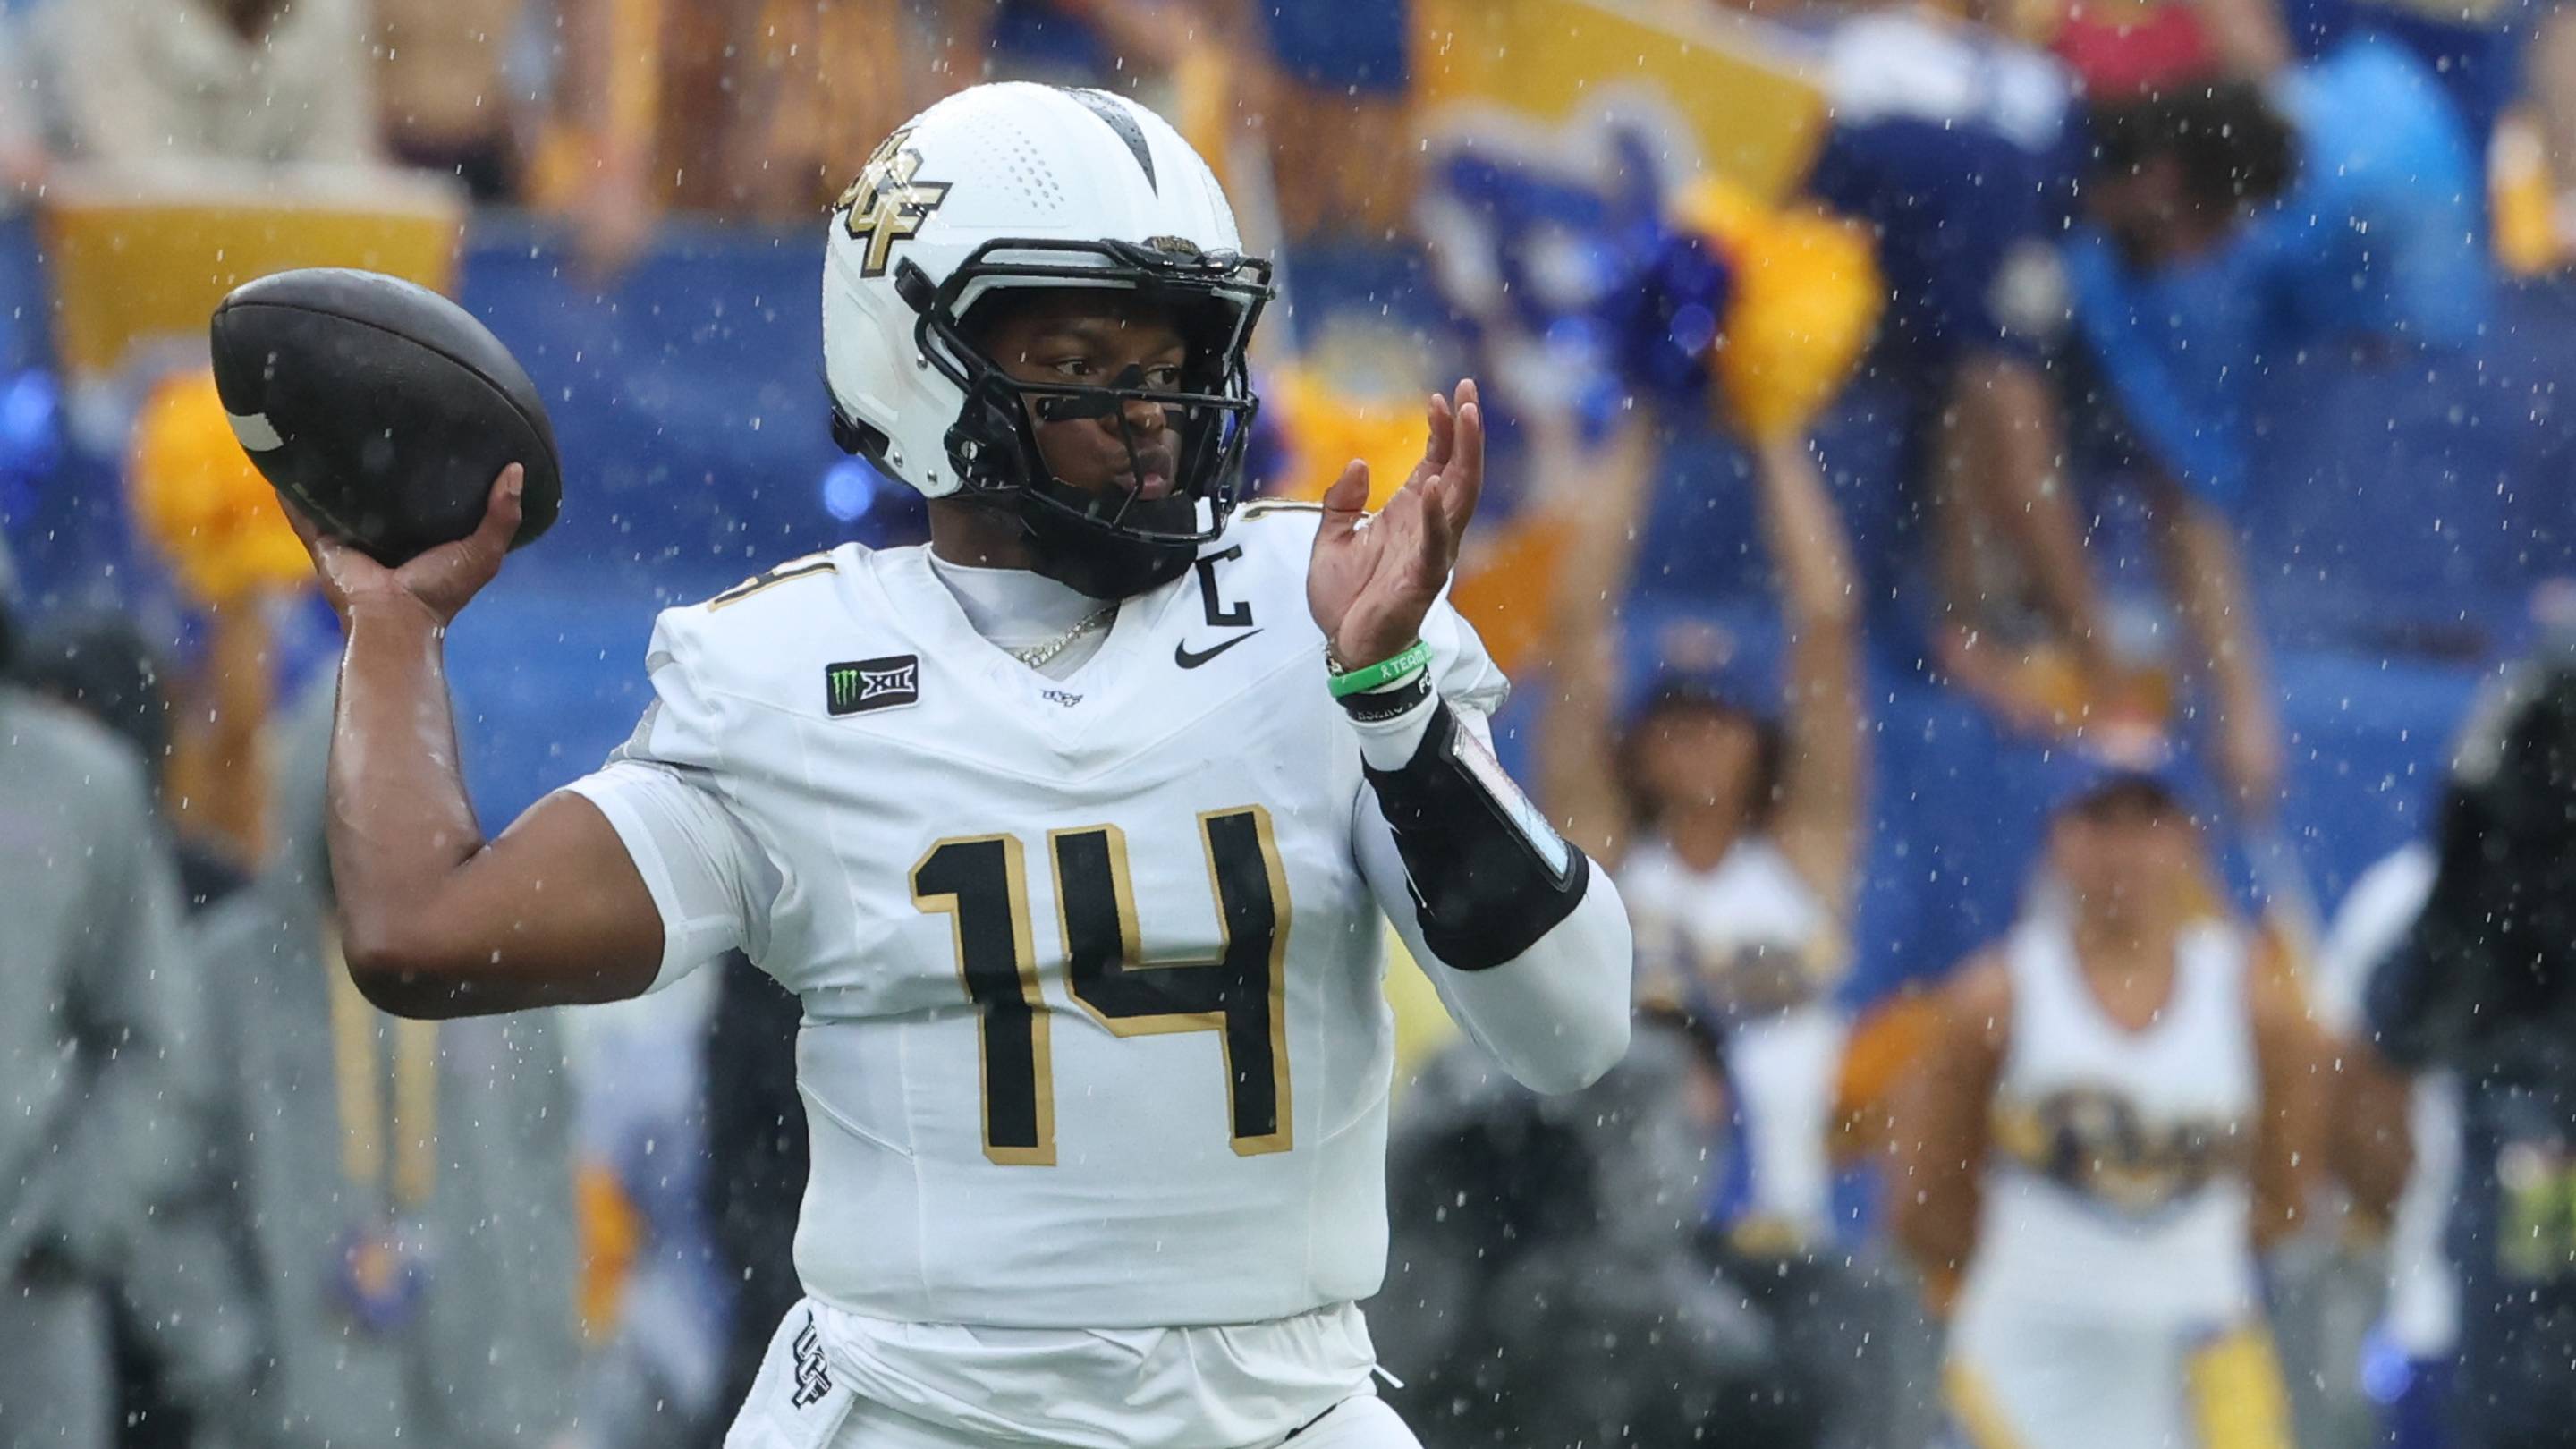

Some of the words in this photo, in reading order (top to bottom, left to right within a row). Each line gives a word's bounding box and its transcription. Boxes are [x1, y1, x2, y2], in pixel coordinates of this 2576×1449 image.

[833, 129, 953, 279] UCF
[1195, 544, 1254, 626] C
[1390, 649, 1426, 674] TEAM
[908, 803, 1293, 1166] 14
[792, 1309, 832, 1411] UCF
